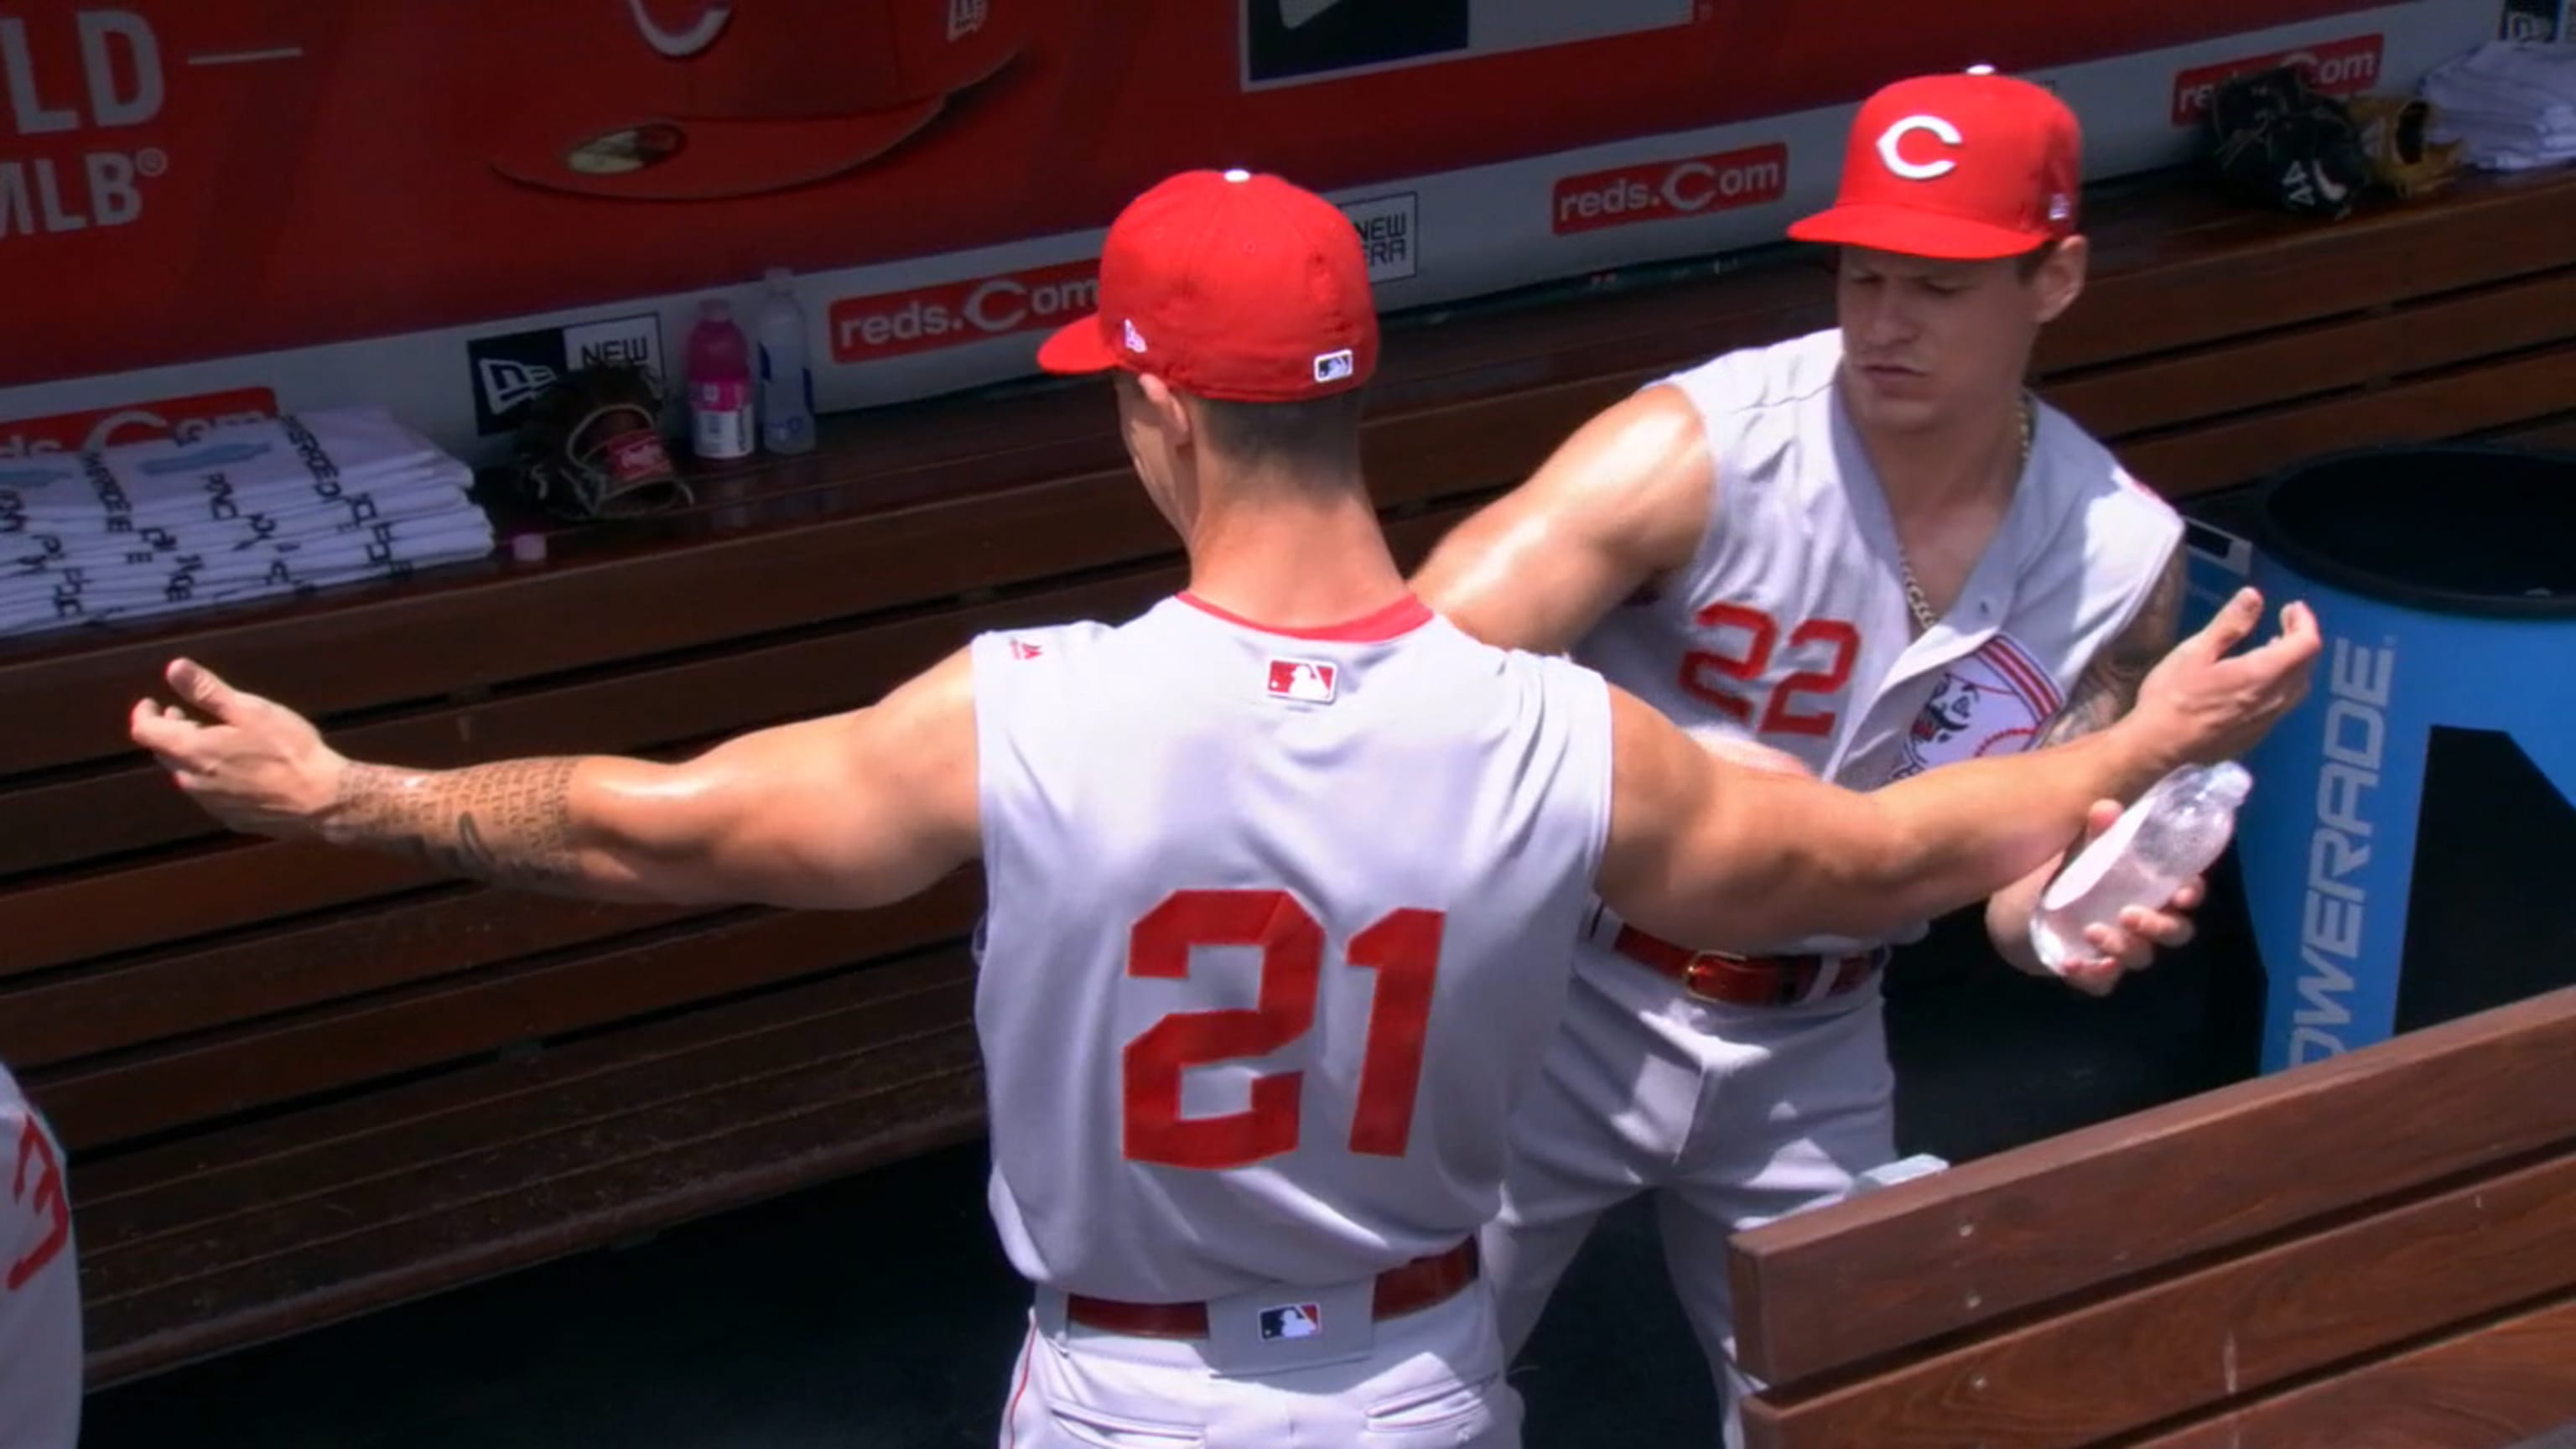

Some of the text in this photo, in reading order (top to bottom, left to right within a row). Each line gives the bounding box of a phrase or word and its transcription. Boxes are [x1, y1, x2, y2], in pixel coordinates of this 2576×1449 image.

[1876, 113, 1965, 181] C
[1559, 160, 1781, 223] reds.Com
[1363, 237, 1407, 267] RA
[580, 336, 650, 366] NEW
[1678, 600, 1863, 738] 22
[1121, 887, 1446, 1171] 21
